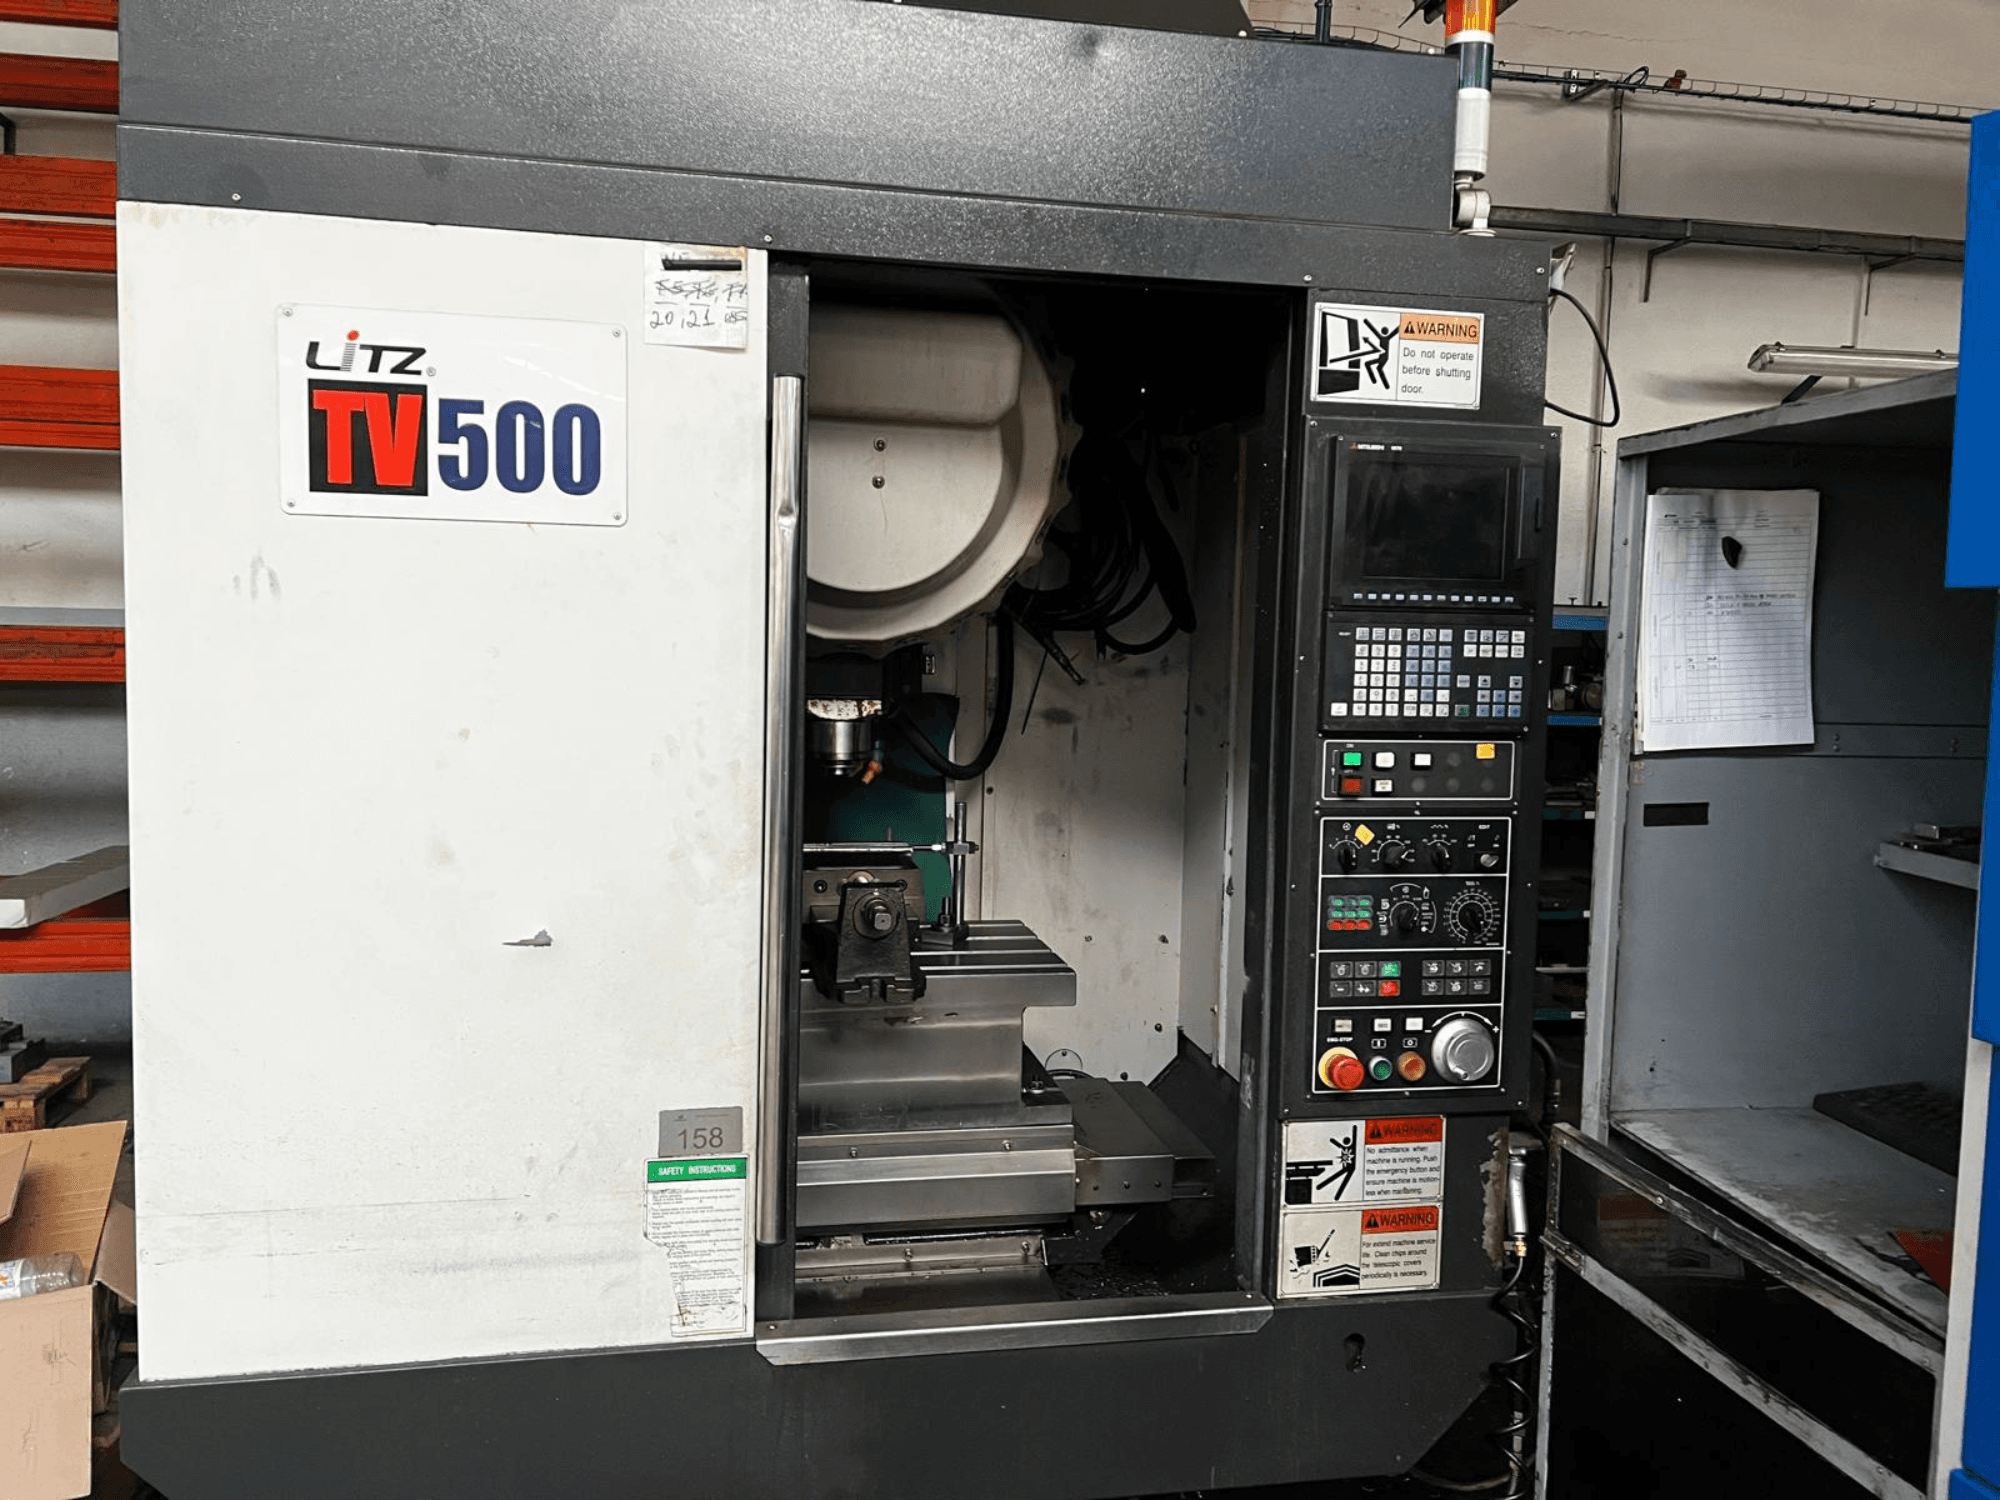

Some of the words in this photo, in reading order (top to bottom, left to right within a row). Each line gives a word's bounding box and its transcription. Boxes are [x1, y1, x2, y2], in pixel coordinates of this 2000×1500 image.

[1417, 321, 1477, 338] WARNING
[1403, 347, 1415, 357] Do
[1421, 350, 1435, 359] not
[1440, 351, 1474, 361] operate
[1402, 365, 1430, 376] before
[1435, 368, 1471, 380] shutting
[1401, 384, 1423, 393] door.
[1383, 1123, 1438, 1136] WARNING
[678, 1126, 724, 1150] 158
[1366, 1157, 1390, 1165] machine
[658, 1166, 684, 1176] SAFETY
[688, 1164, 736, 1175] INSTRUCTIONS
[1376, 1167, 1407, 1176] emergency
[1386, 1177, 1411, 1185] machine
[1380, 1213, 1435, 1226] WARNING
[1375, 1250, 1390, 1258] Clean
